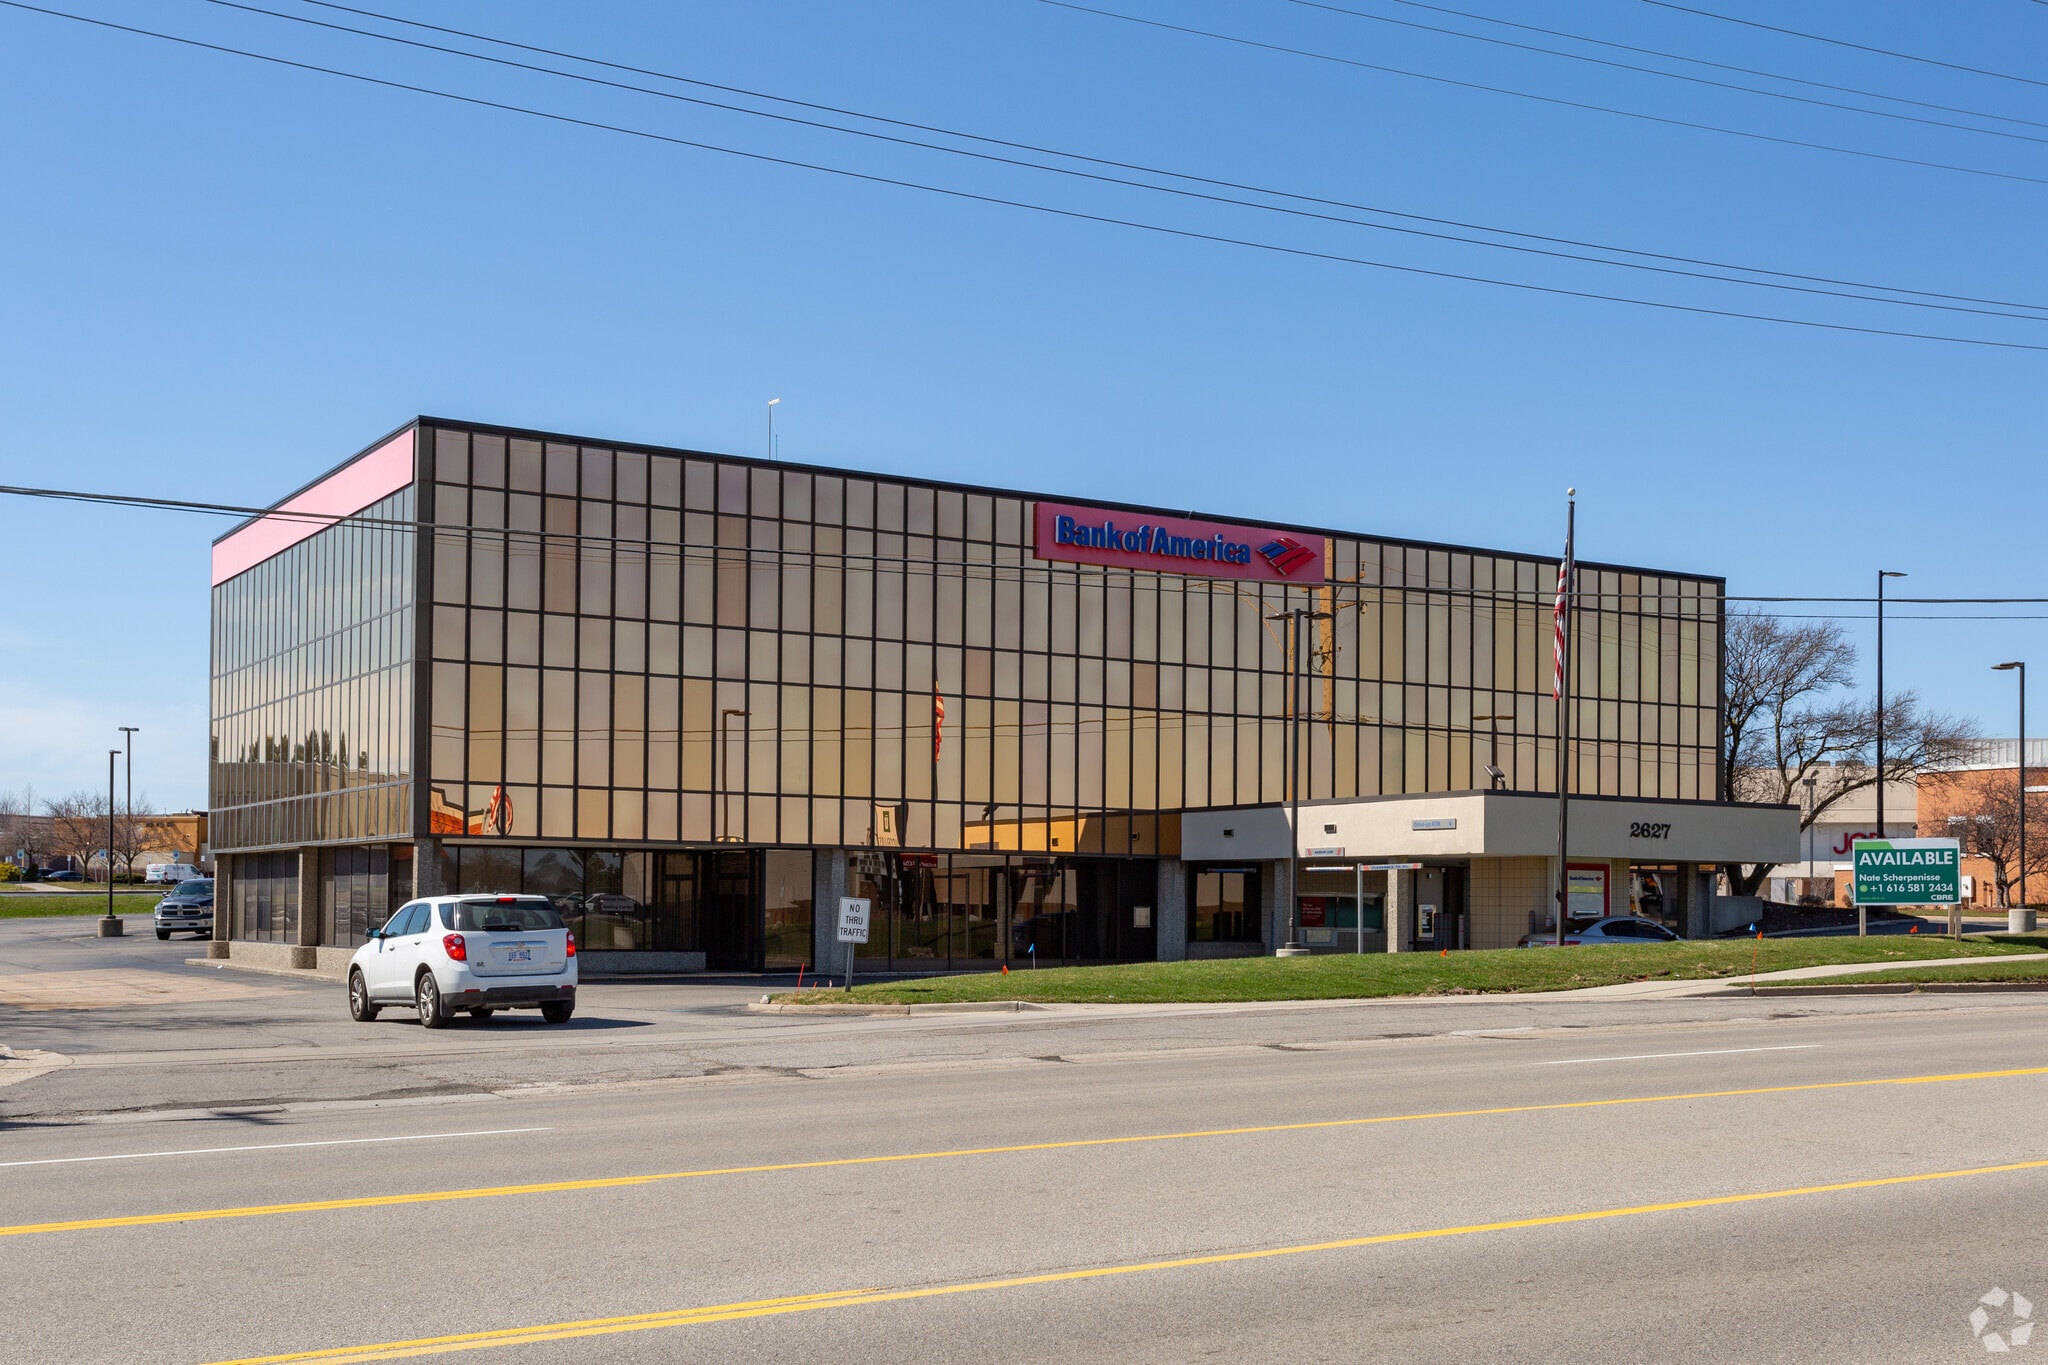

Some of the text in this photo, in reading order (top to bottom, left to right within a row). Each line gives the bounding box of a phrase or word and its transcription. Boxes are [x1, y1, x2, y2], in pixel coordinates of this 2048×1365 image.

[1055, 515, 1251, 565] Bank of America
[1629, 821, 1672, 840] 2627
[1858, 851, 1954, 866] AVAILABLE
[1859, 872, 1941, 883] Nate Scherpenisse
[1870, 883, 1953, 893] +1 616 581 2434
[849, 904, 861, 913] NO
[845, 915, 864, 925] THRU
[839, 926, 868, 938] TRAFFIC
